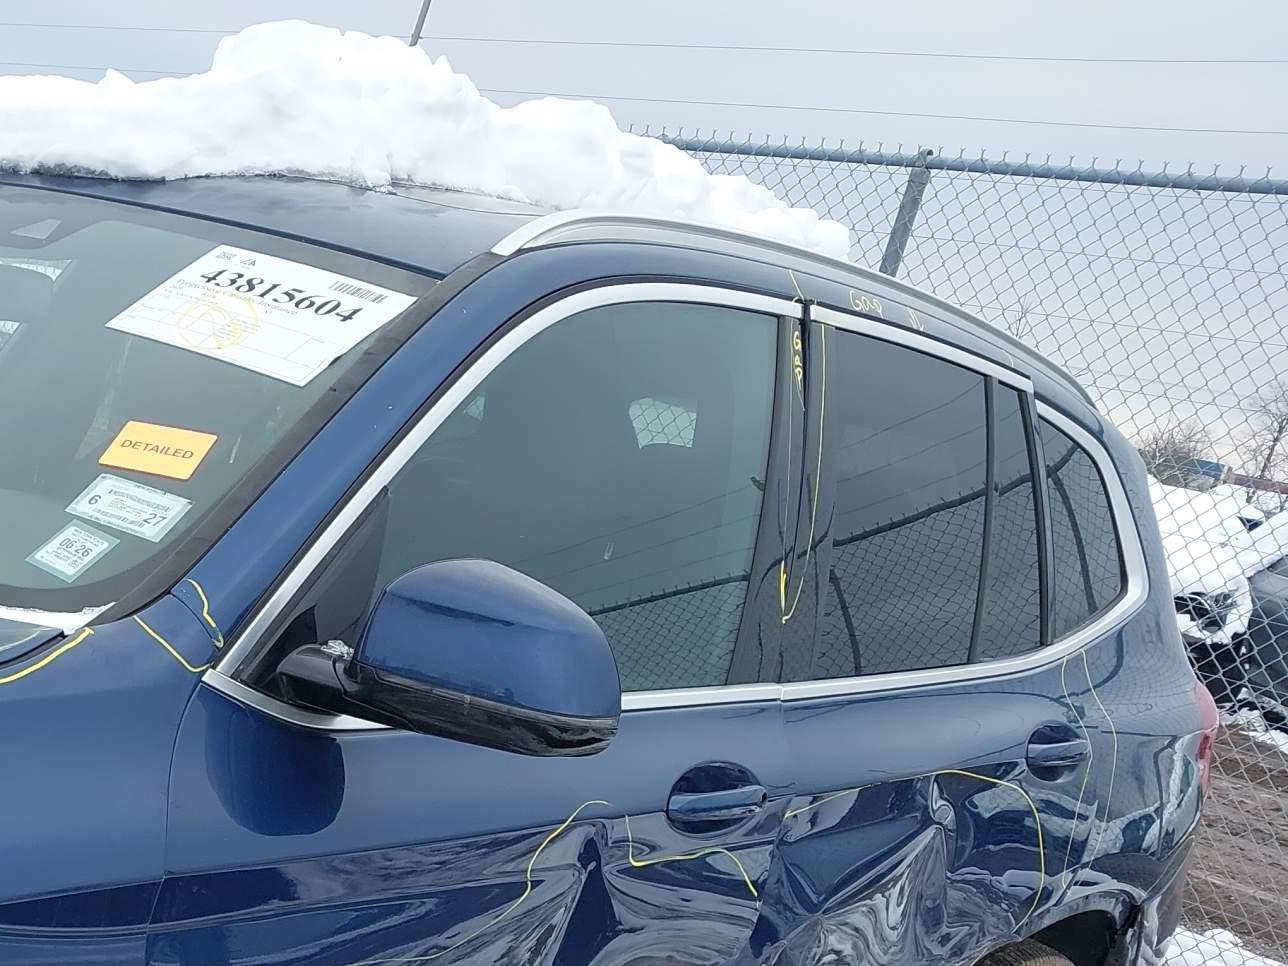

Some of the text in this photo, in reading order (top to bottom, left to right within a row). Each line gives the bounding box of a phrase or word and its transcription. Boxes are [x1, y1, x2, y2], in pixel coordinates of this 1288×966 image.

[200, 269, 363, 323] 43815604
[120, 438, 195, 460] DETAILED
[88, 495, 101, 505] 6
[143, 512, 167, 527] 27
